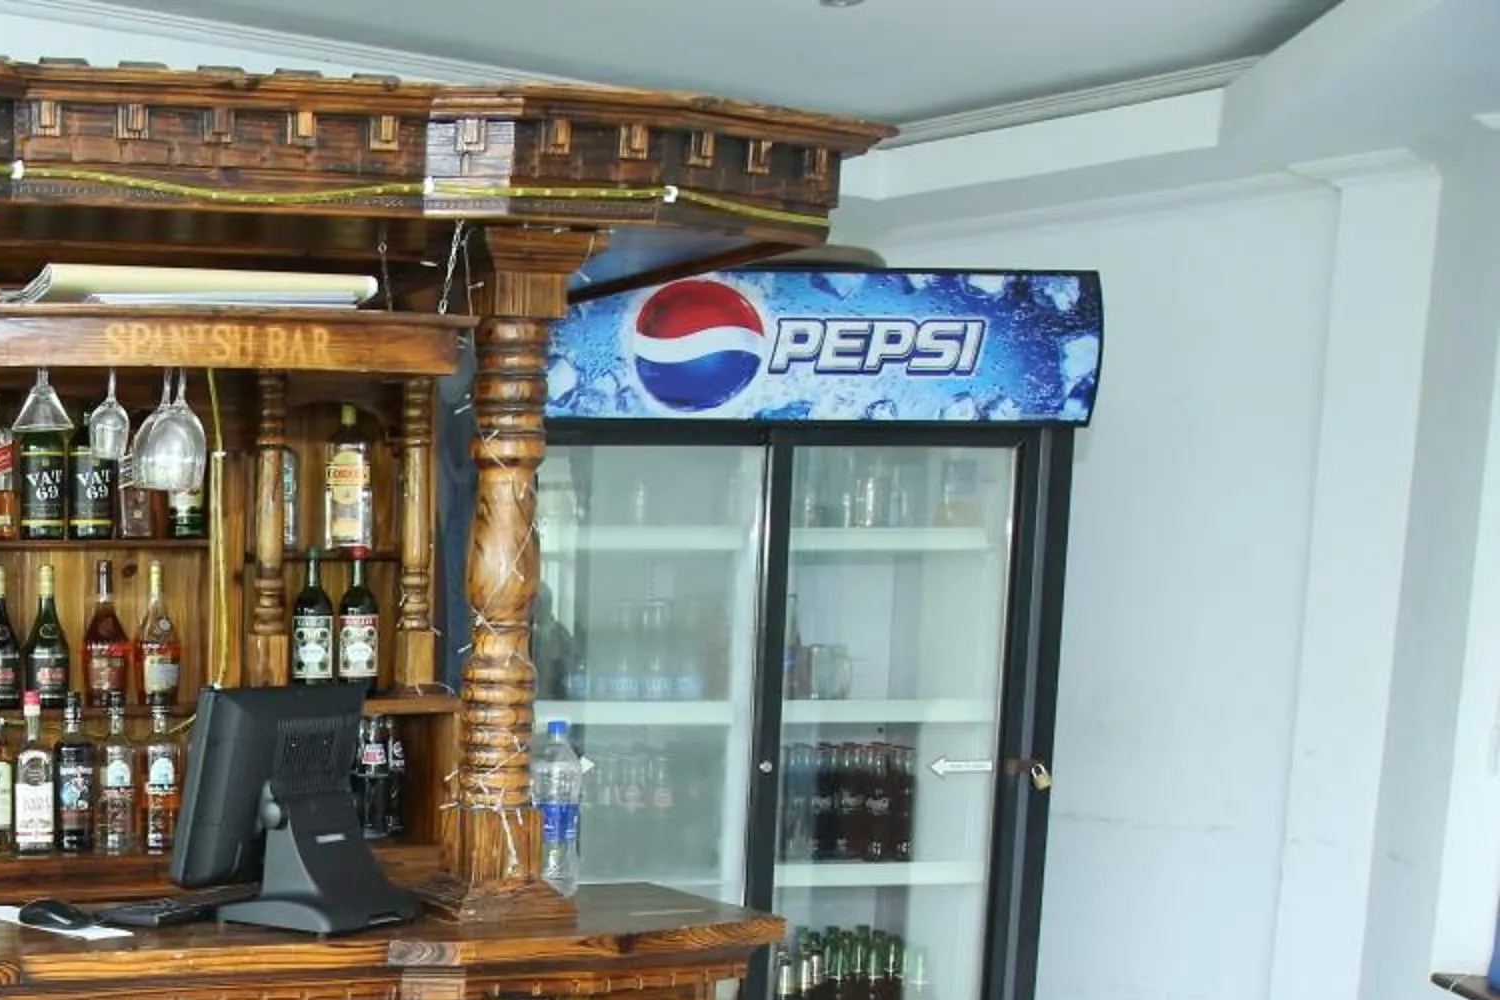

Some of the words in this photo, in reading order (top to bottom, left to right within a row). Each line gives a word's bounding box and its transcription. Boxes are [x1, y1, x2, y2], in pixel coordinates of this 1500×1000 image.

[104, 320, 256, 366] SPANISH
[265, 323, 334, 366] BAR
[767, 317, 986, 376] PEPSI
[25, 469, 63, 488] VAT
[76, 469, 111, 488] VAT
[35, 485, 60, 501] 69
[86, 485, 109, 500] 69
